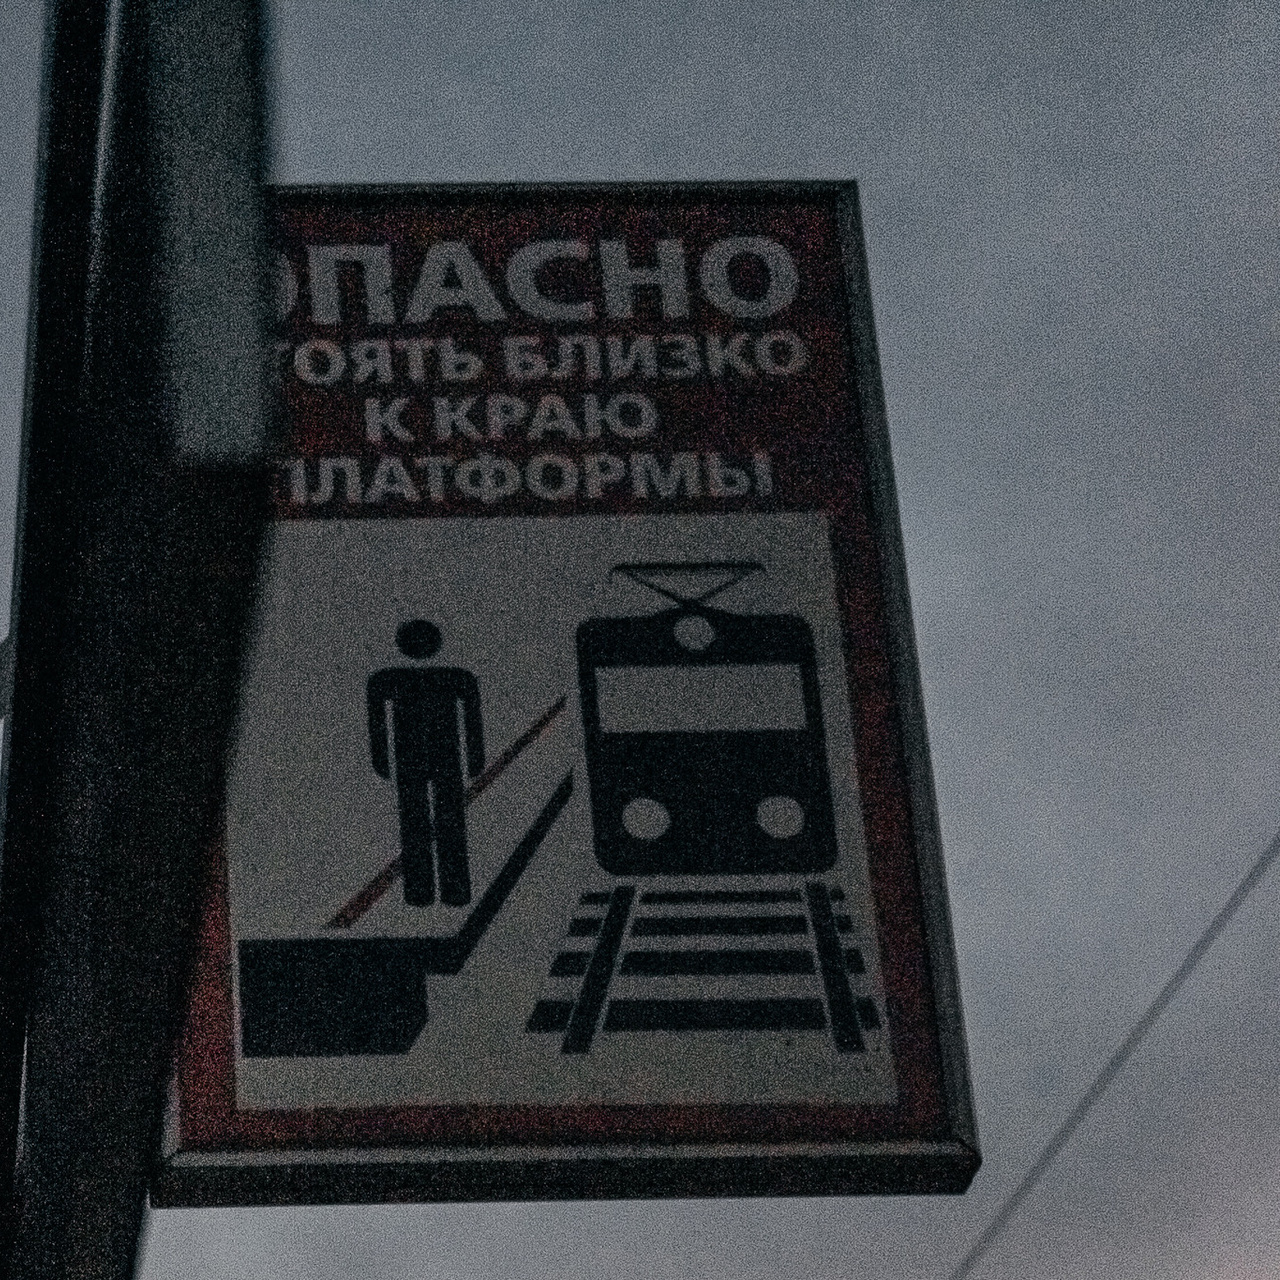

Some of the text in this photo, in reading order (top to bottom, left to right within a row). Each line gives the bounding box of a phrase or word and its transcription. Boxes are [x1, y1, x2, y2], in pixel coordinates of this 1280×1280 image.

[271, 330, 808, 384] ОЯТЬ БЛИЗКО
[365, 393, 658, 442] К КРАЮ
